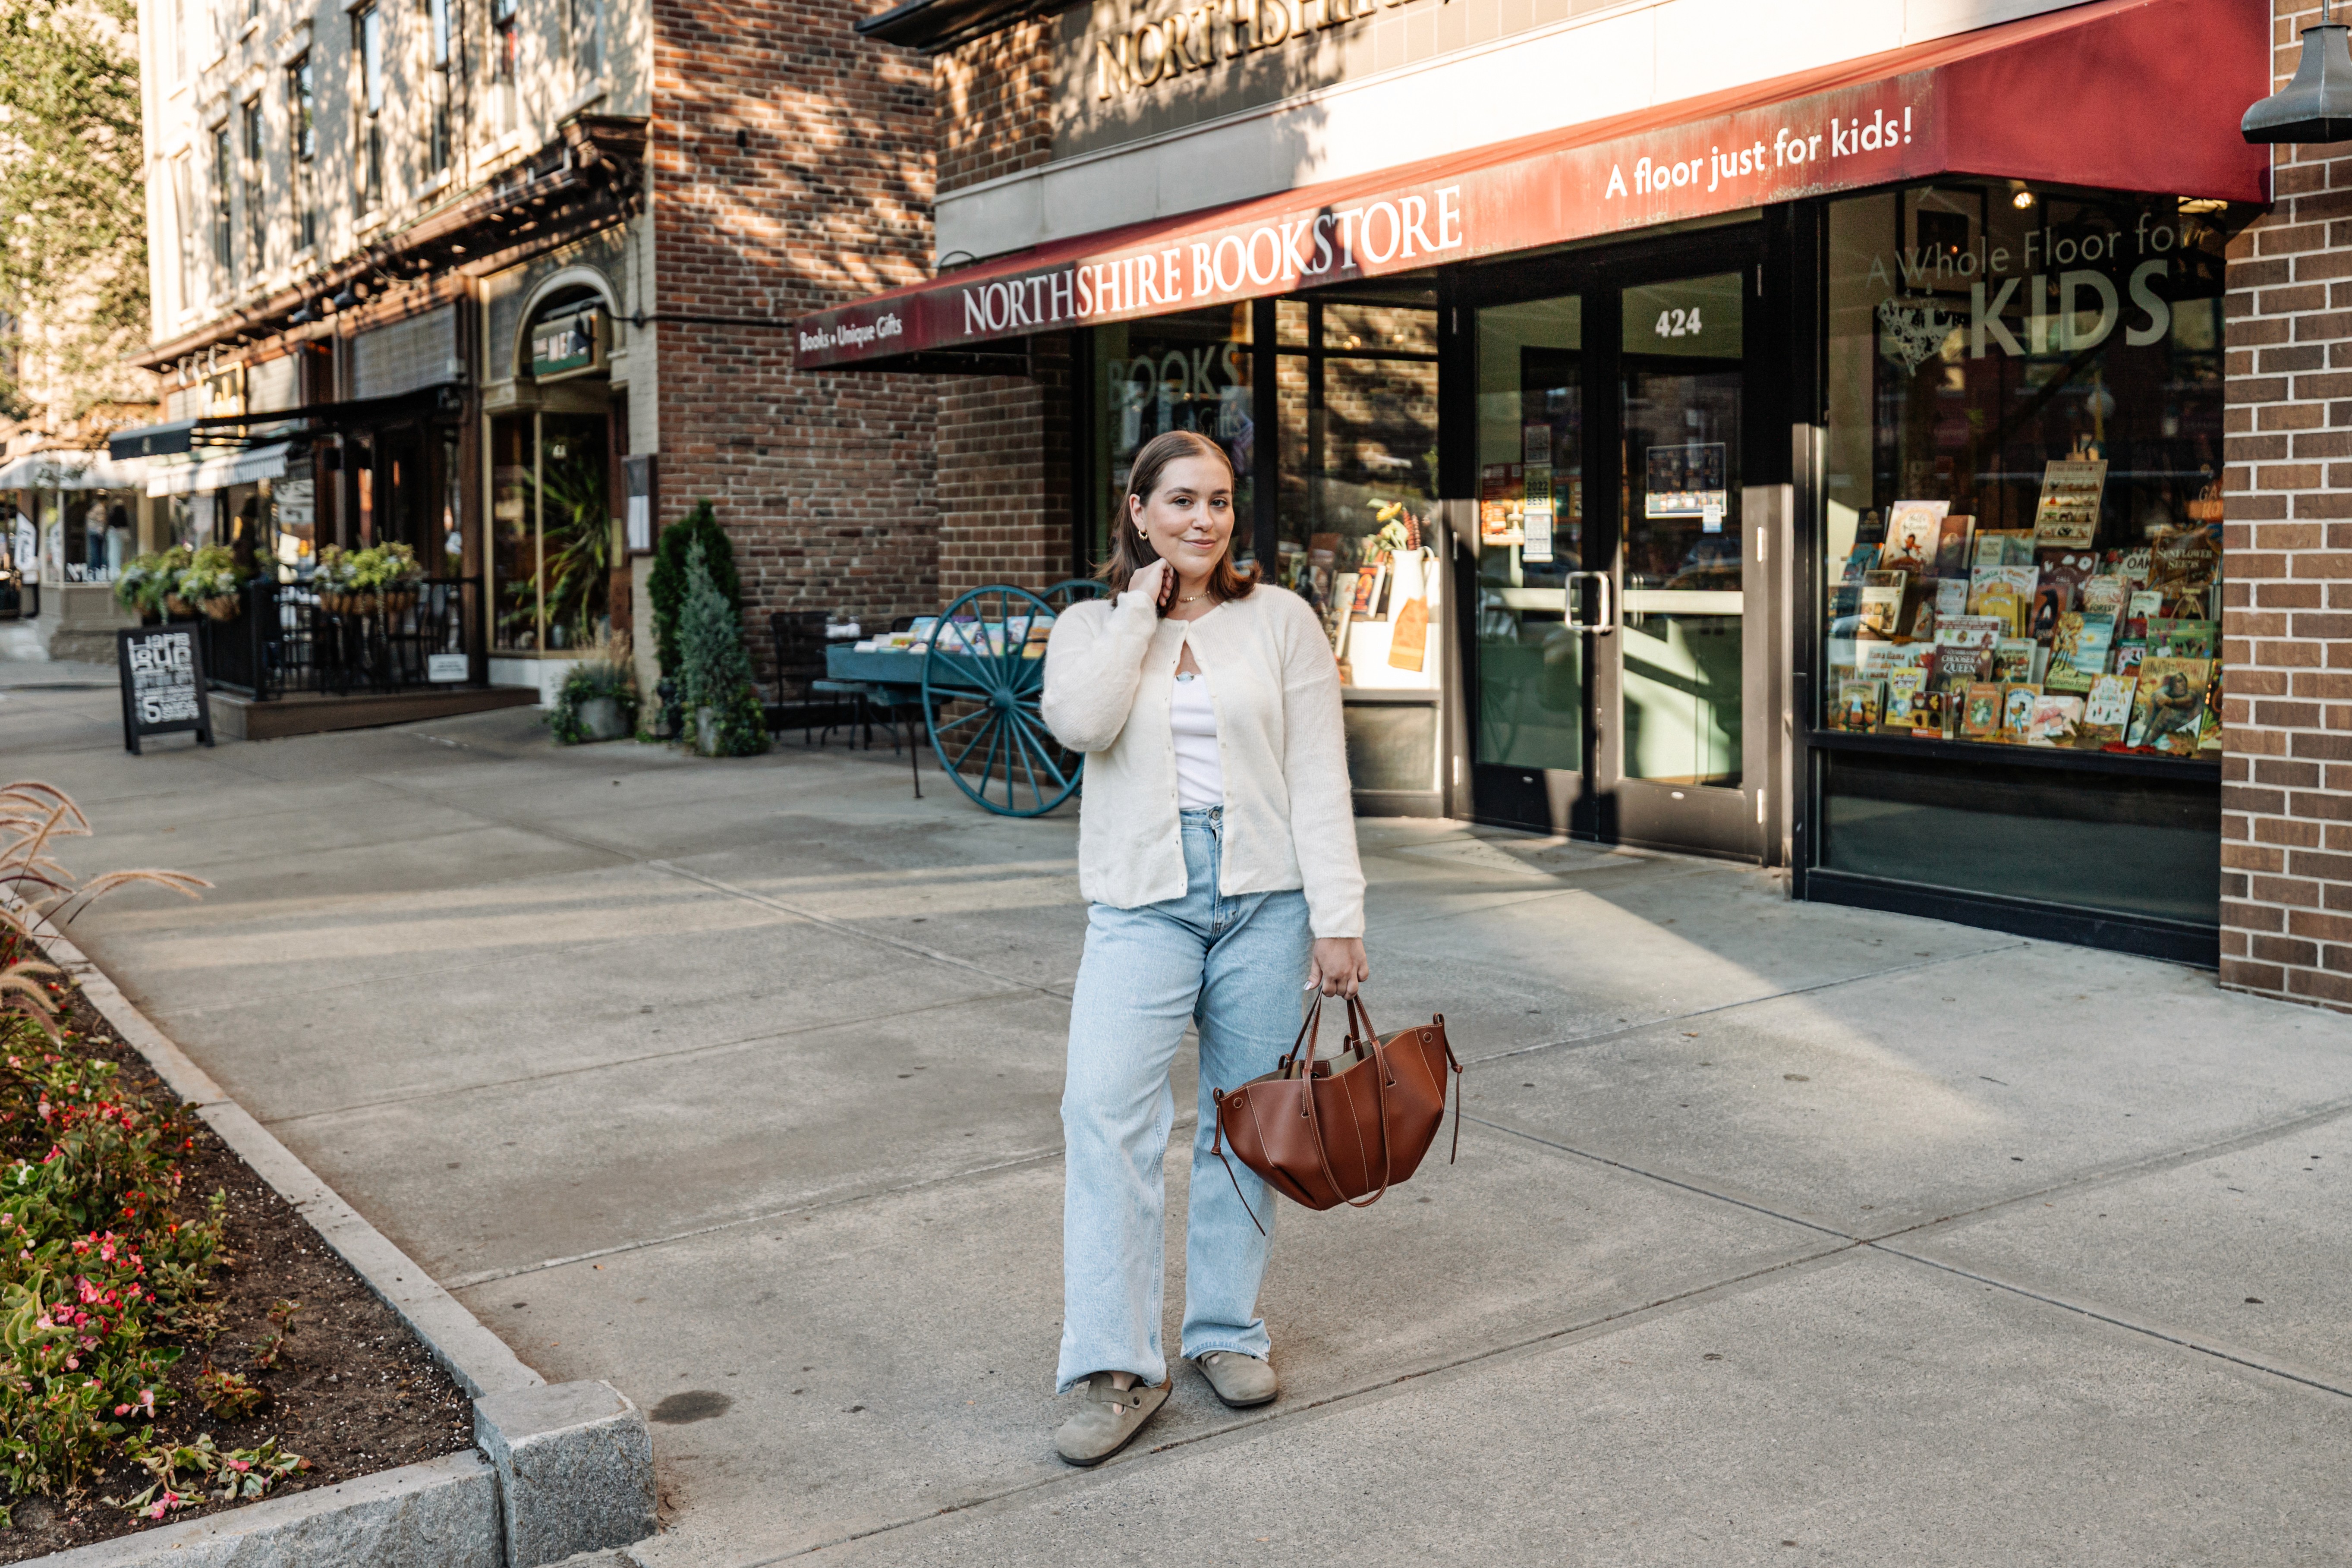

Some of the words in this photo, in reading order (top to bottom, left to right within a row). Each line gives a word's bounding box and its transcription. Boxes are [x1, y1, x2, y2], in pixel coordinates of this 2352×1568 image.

[1606, 164, 1628, 199] A
[1634, 157, 1703, 195] floor
[1708, 141, 1766, 192] just
[1774, 127, 1822, 167] for
[1831, 106, 1911, 158] kids!
[963, 247, 1182, 335] NORTHSHIRE
[1190, 185, 1463, 298] BOOKSTORE
[1866, 255, 1890, 287] A
[1895, 235, 2009, 284] Whole
[2024, 227, 2121, 269] Floor
[2136, 213, 2186, 254] for
[800, 327, 830, 352] Books
[837, 323, 875, 348] Unique
[876, 312, 903, 338] Gifts
[1656, 307, 1702, 338] 424
[1970, 259, 2170, 359] KIDS
[1107, 341, 1239, 412] BOOKS
[1527, 496, 1548, 505] BEST
